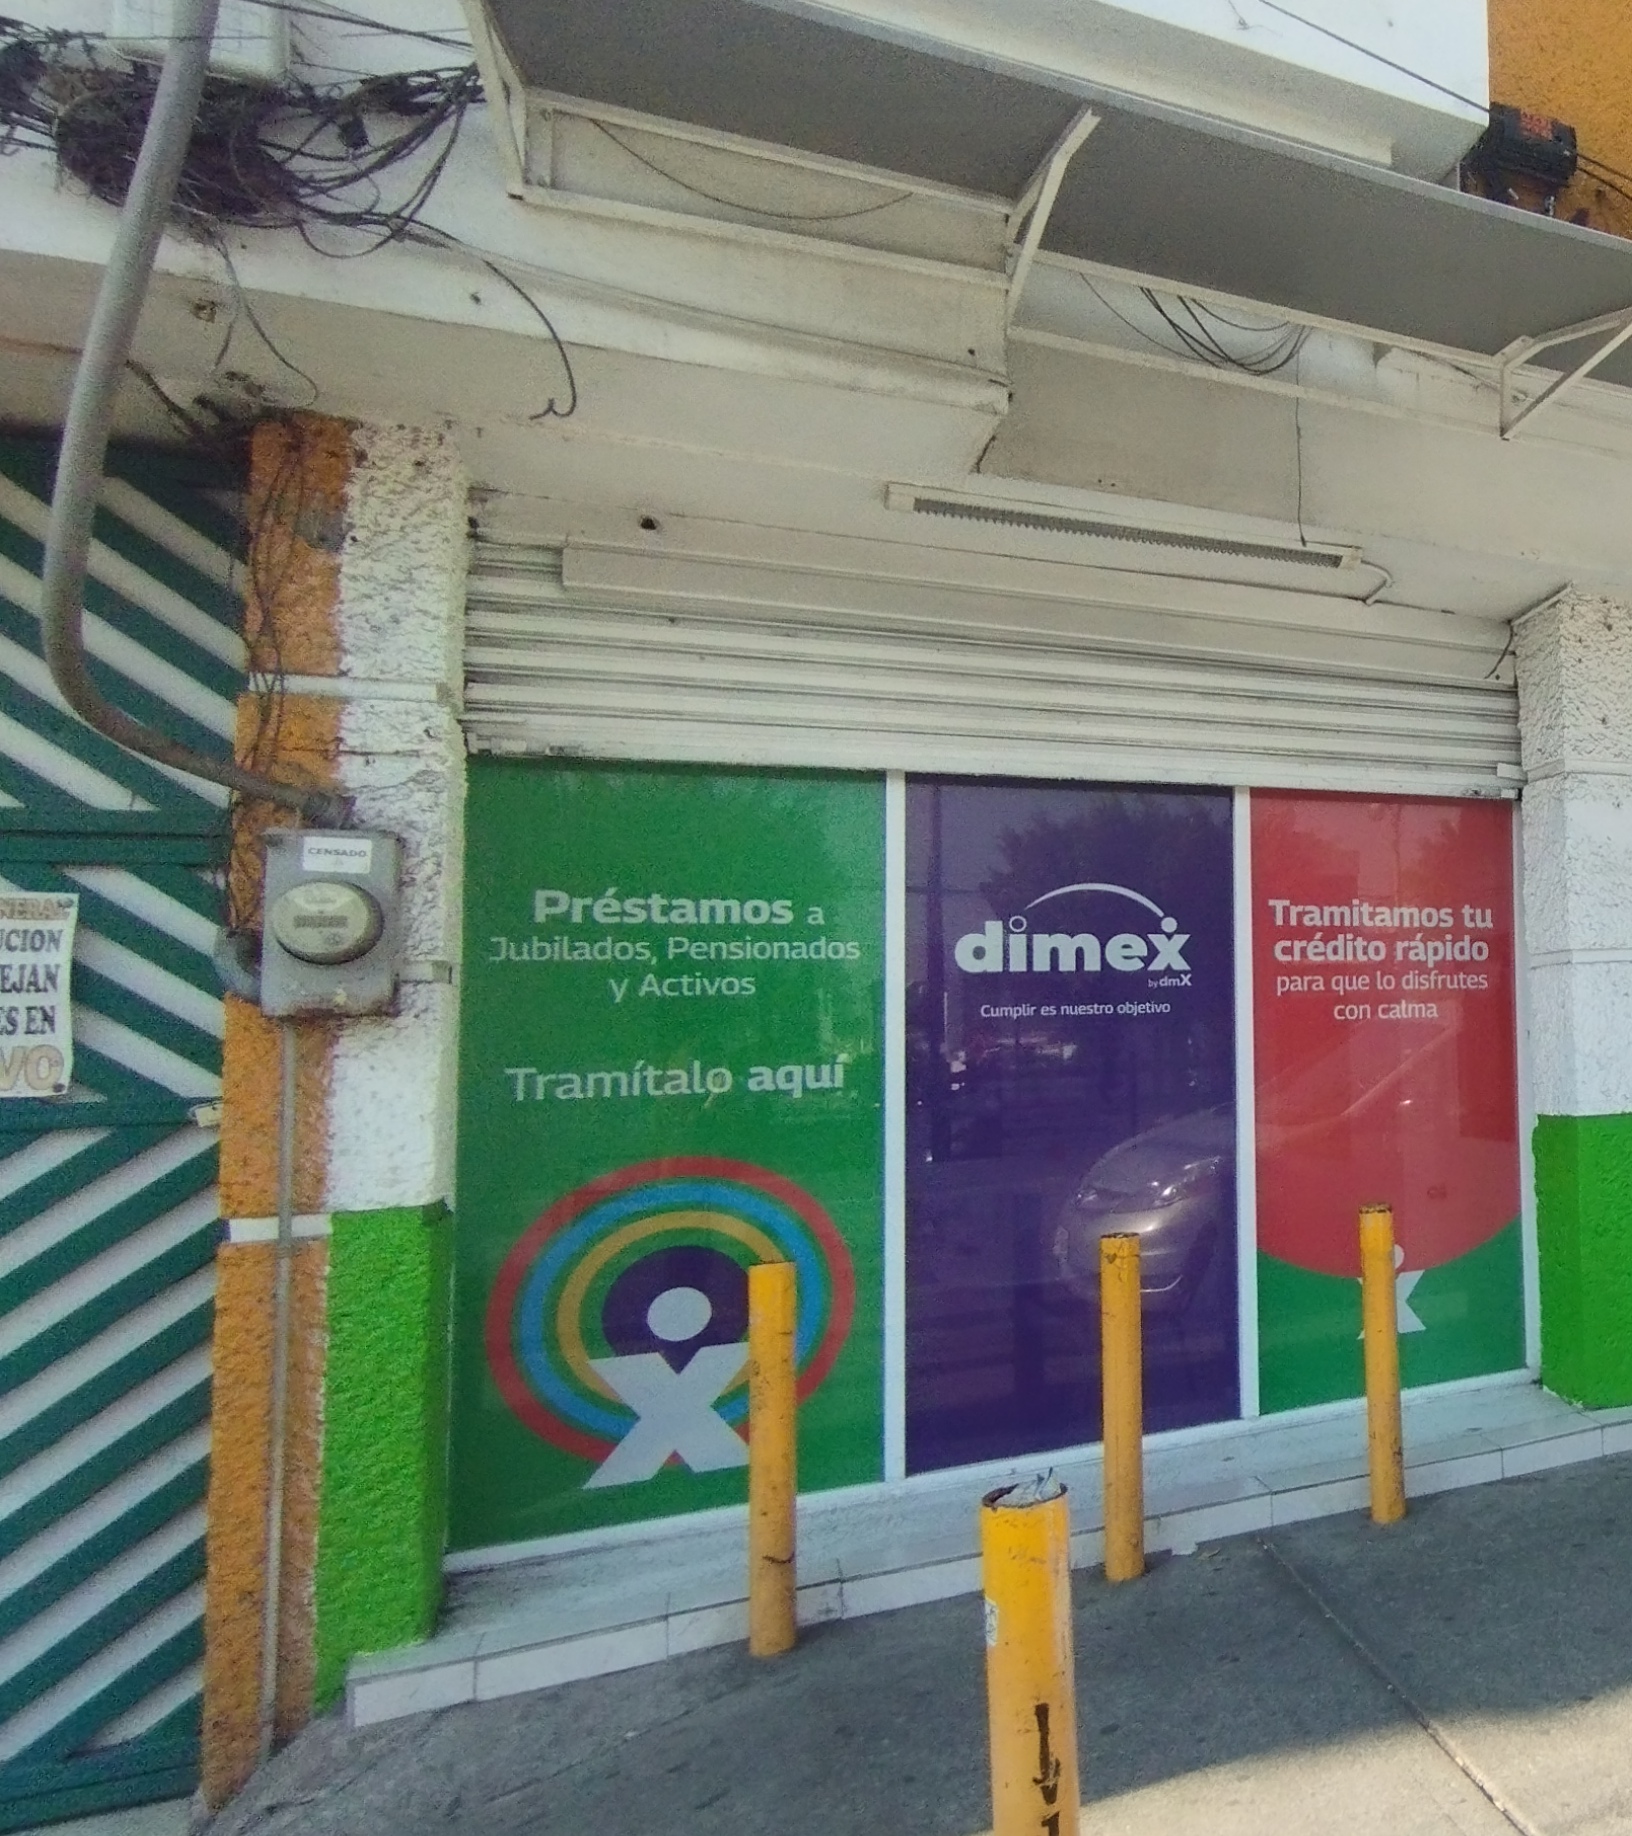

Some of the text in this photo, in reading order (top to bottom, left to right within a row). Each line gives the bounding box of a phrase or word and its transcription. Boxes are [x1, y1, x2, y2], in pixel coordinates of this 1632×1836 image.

[307, 847, 368, 858] CENSADO
[533, 887, 825, 925] Préstamos a
[1268, 899, 1494, 929] Tramitamos tu
[489, 935, 860, 965] Jubilados, Pensionados
[954, 914, 1192, 973] dimex
[1274, 932, 1490, 968] crédito rápido
[0, 963, 60, 994] EJAN
[610, 972, 756, 1003] y Activos
[1277, 970, 1489, 996] para que lo disfrutes
[24, 1005, 56, 1035] EN
[980, 1000, 1171, 1018] Cumplir es nuestro objetivo
[1334, 999, 1439, 1020] con calma
[504, 1053, 850, 1102] Tramítalo aquí
